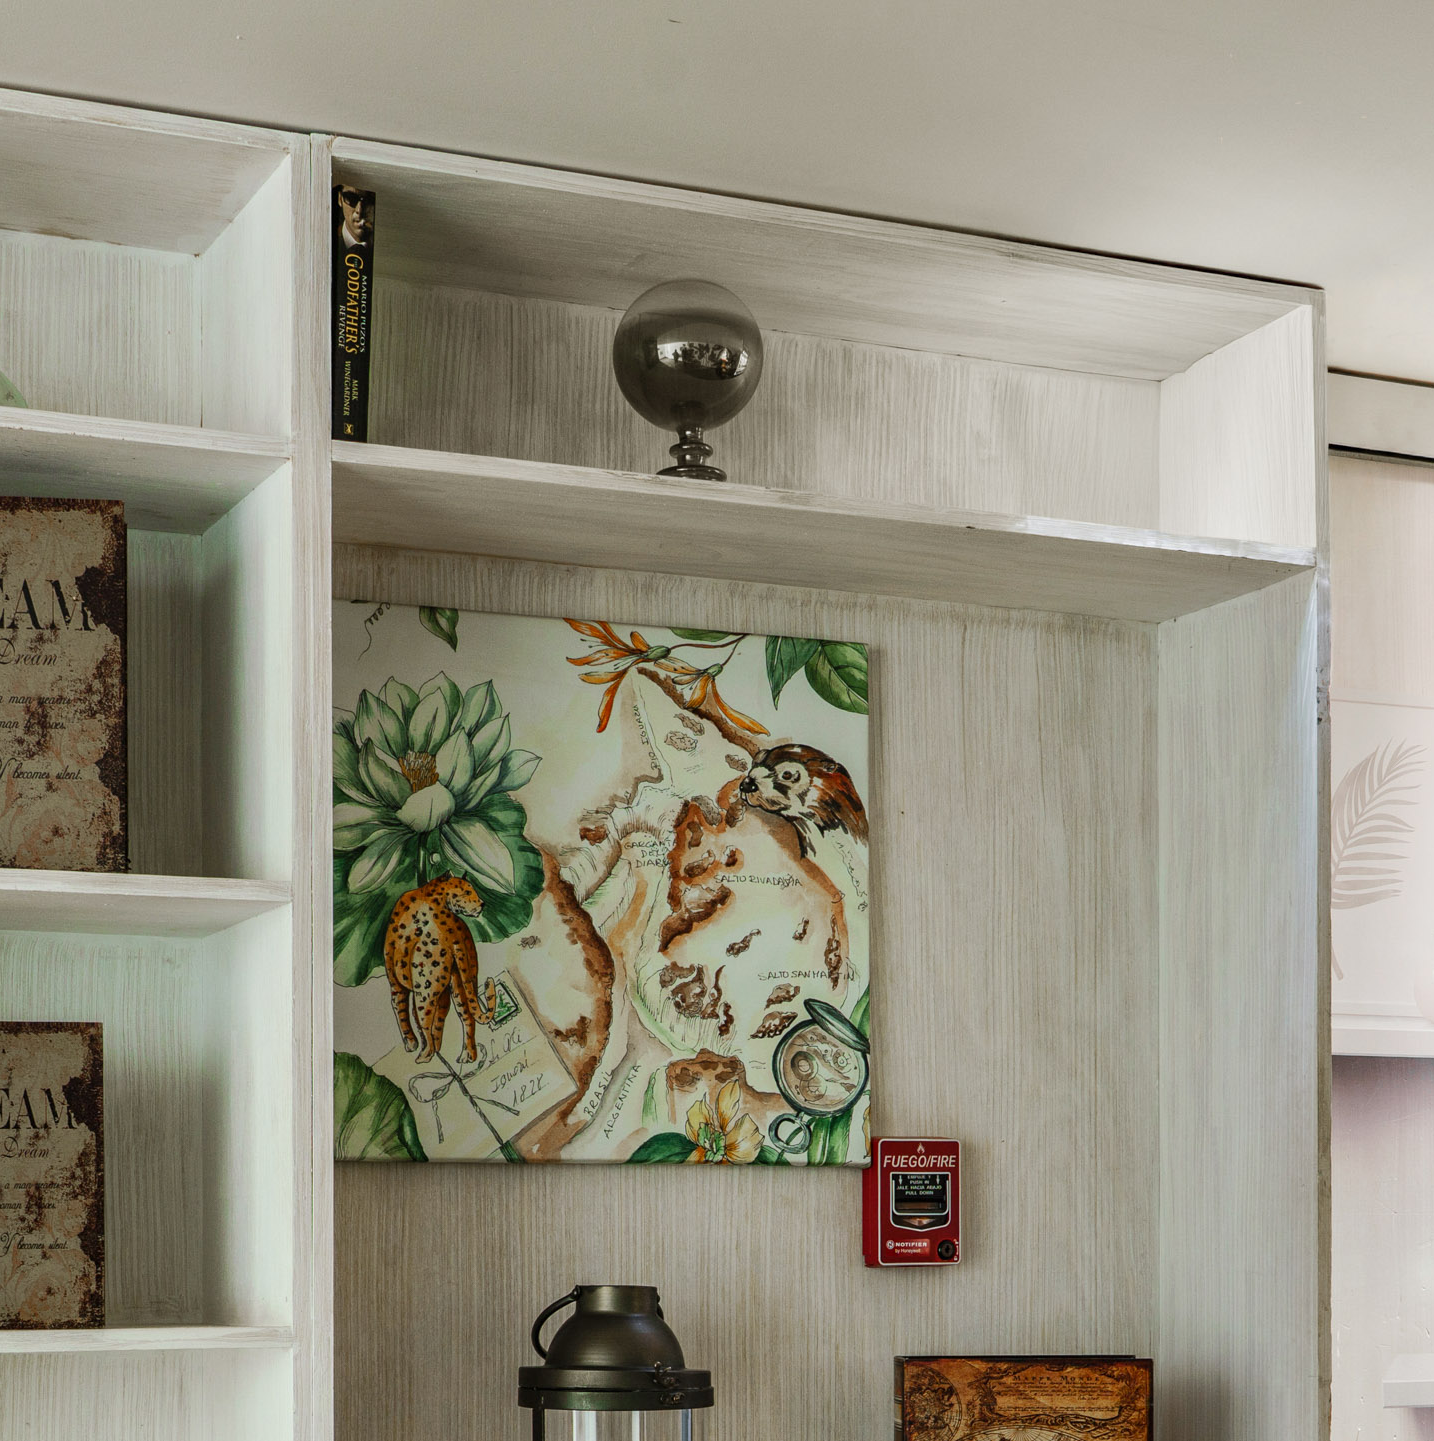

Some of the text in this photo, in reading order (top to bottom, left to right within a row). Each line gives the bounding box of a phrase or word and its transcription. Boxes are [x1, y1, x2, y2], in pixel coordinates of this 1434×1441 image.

[338, 253, 364, 354] GODFATHER'S REVENGE
[360, 275, 368, 313] MARIO
[342, 360, 352, 416] WINEGARDNER
[351, 379, 359, 401] MARK
[8, 695, 32, 704] man
[13, 763, 50, 780] becomes
[714, 874, 747, 884] SALTO
[758, 971, 811, 981] SALTO SAN
[583, 1070, 613, 1117] BRASIL
[603, 1064, 641, 1139] ARGENTINA
[0, 1136, 49, 1159] Dream
[883, 1155, 957, 1168] FUEGO/FIRE
